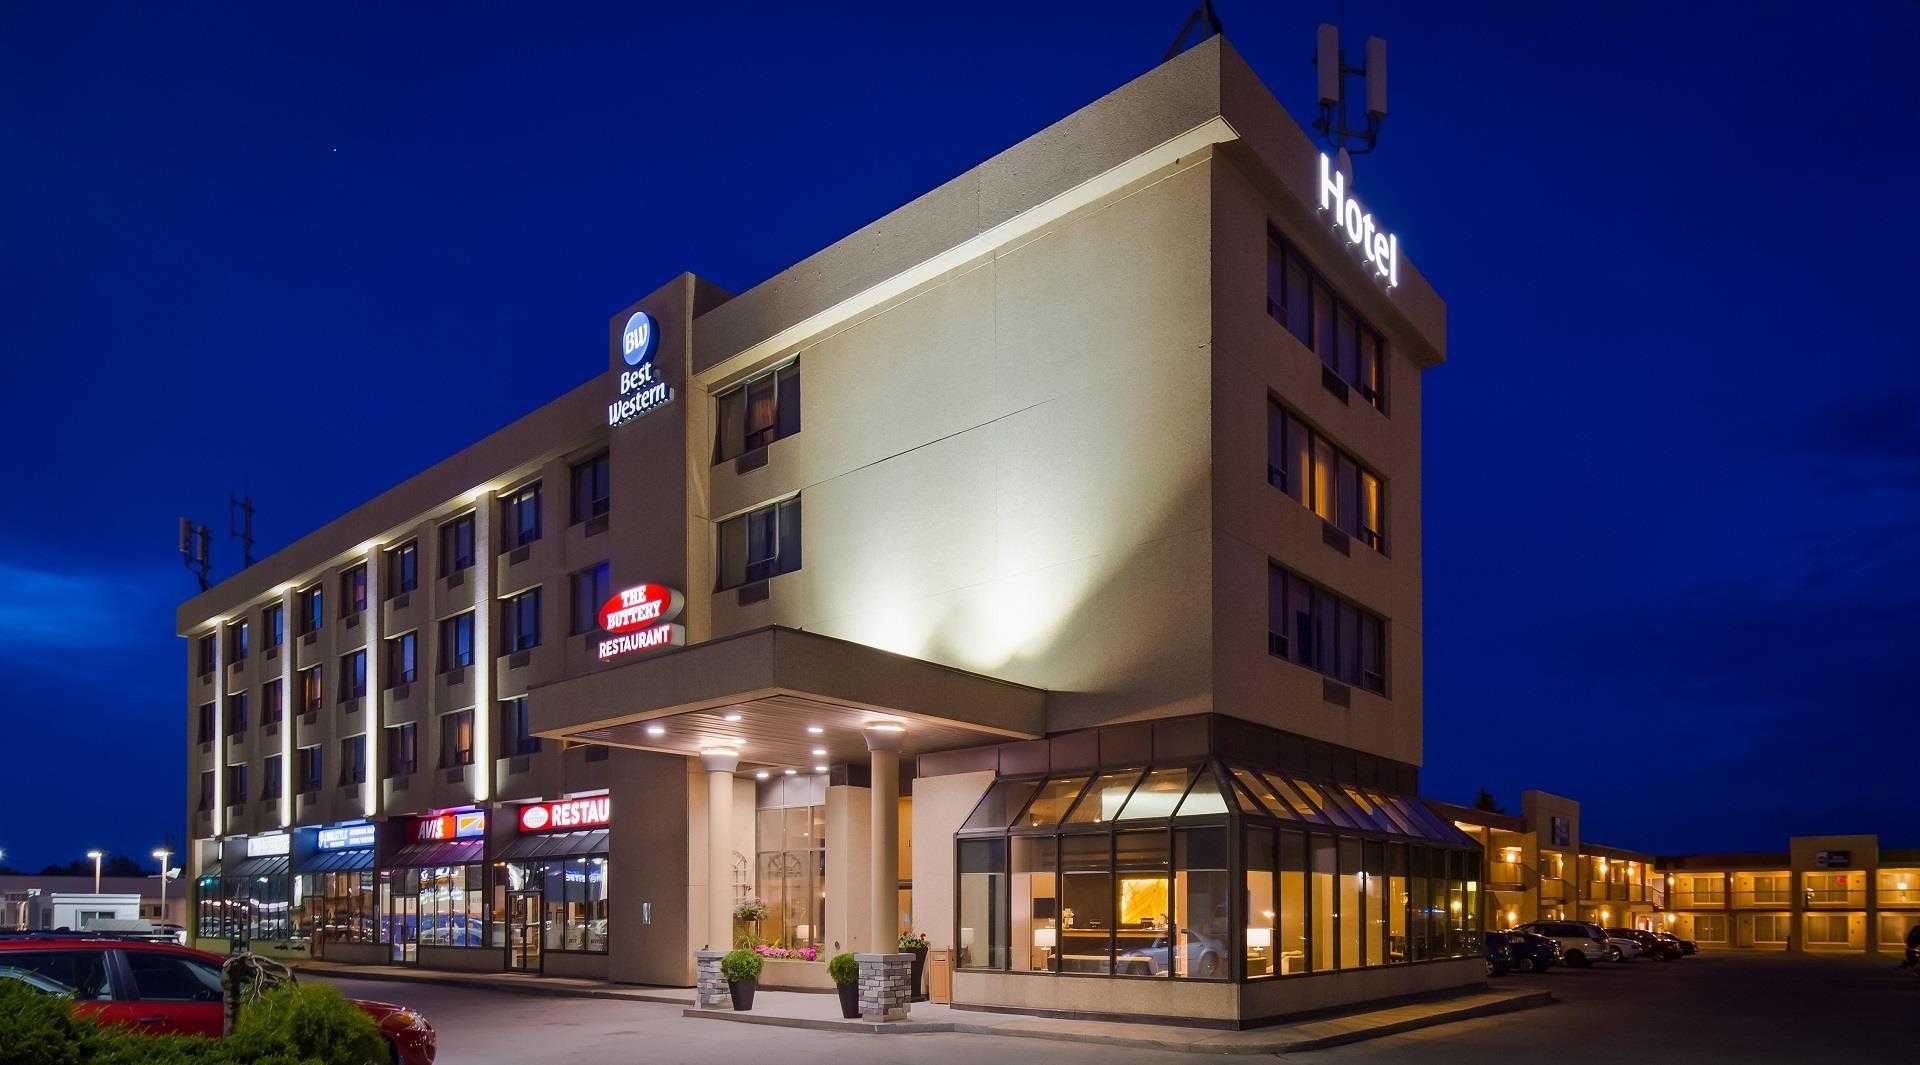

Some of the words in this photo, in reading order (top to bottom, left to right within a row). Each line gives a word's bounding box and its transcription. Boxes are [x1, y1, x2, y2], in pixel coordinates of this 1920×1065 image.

[1320, 152, 1398, 288] Hotel
[625, 323, 648, 355] BW
[620, 361, 652, 395] Best
[608, 382, 665, 426] Western
[621, 585, 647, 608] THE
[607, 599, 662, 631] BUTTERY
[599, 624, 671, 659] RESTAURANT
[418, 818, 443, 840] AVIS
[551, 799, 610, 827] RESTAU
